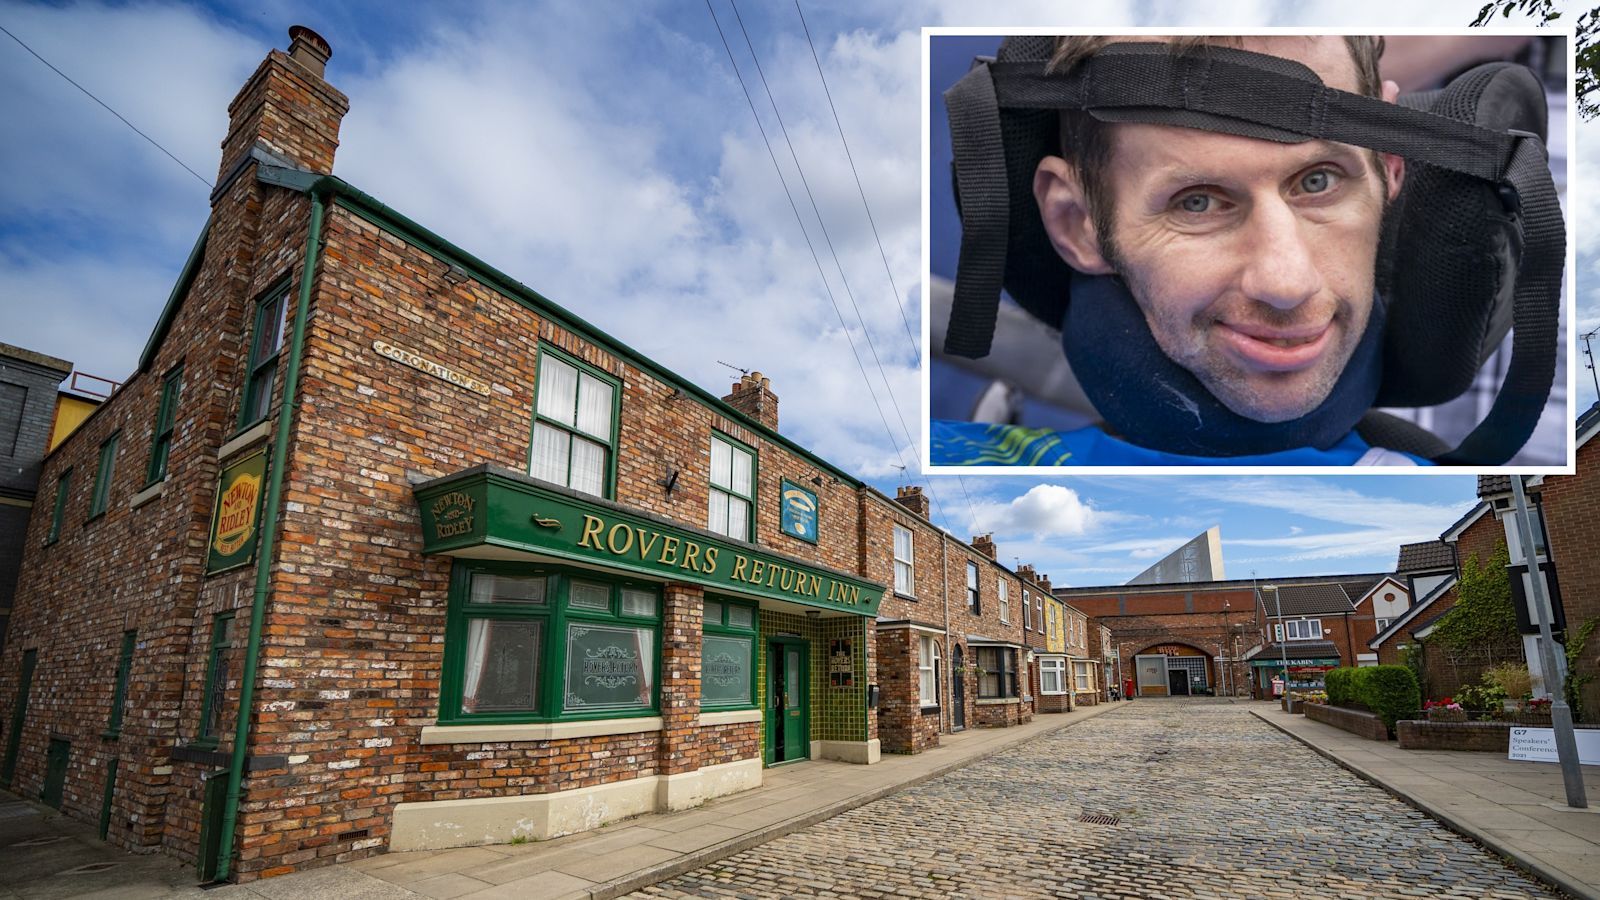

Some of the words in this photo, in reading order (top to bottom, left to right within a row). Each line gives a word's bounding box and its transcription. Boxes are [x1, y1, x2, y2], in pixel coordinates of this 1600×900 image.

[381, 345, 467, 386] CORONATION
[223, 482, 257, 508] NEWTON
[431, 492, 475, 521] NEWTON
[219, 505, 253, 534] RIDLEY
[436, 516, 474, 538] RIDLEY
[577, 514, 719, 574] ROVERS
[730, 554, 823, 598] RETURN
[827, 580, 860, 605] INN
[1512, 737, 1551, 745] Speakers'
